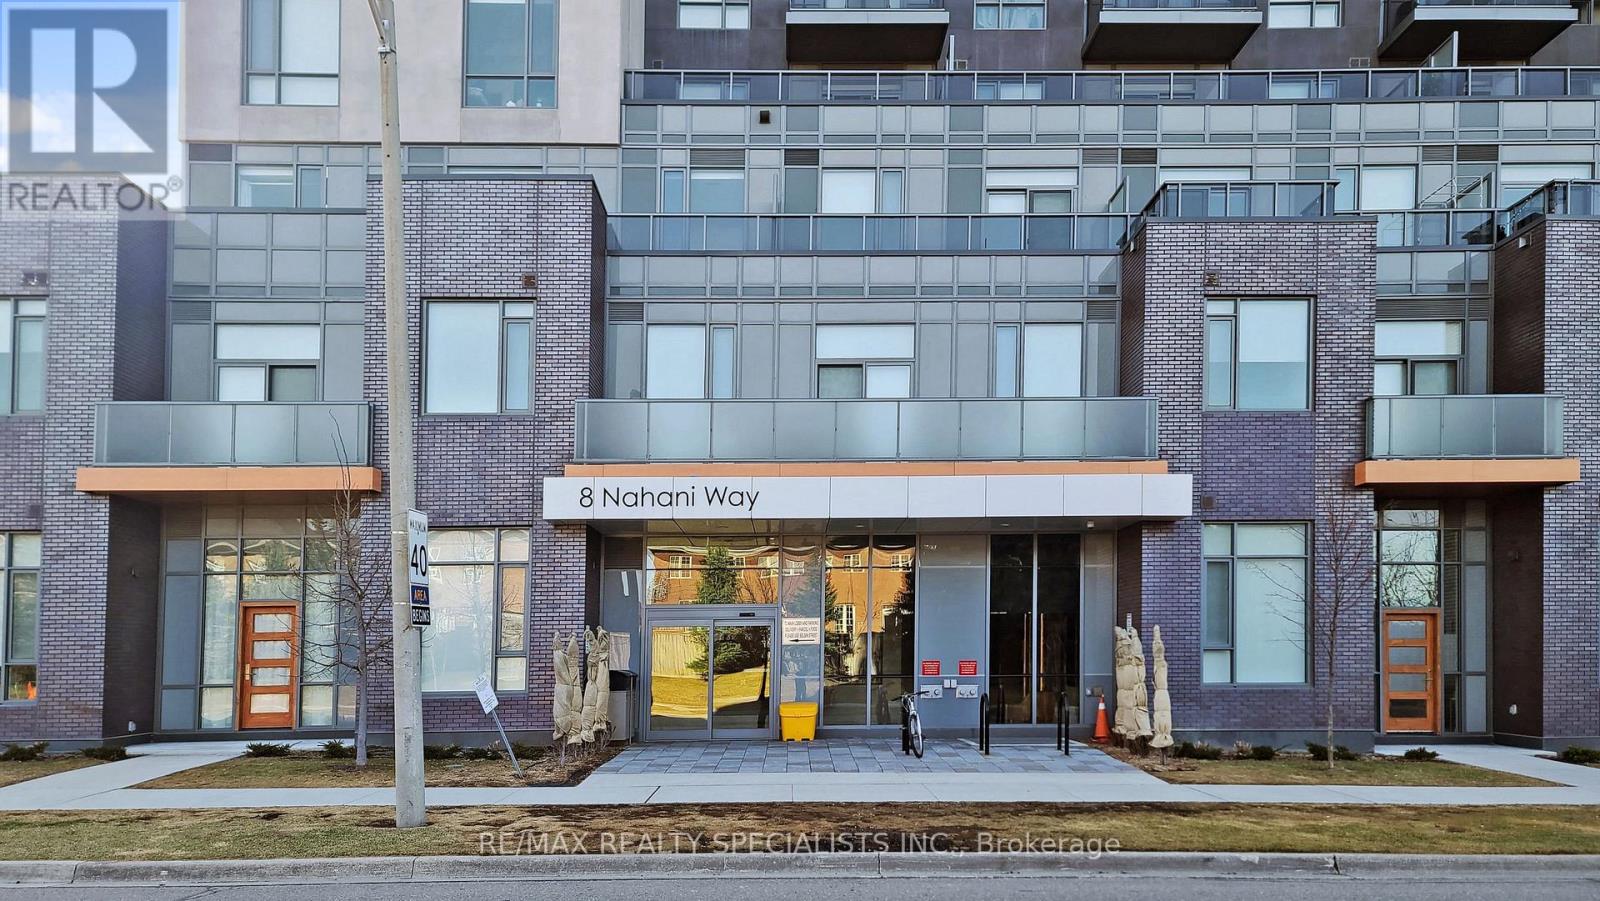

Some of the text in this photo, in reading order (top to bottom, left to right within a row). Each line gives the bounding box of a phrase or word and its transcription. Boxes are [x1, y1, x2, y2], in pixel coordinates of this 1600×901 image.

[579, 486, 760, 511] 8 Nahani Way
[411, 543, 427, 576] 40
[413, 589, 428, 601] AREA
[412, 608, 430, 623] BEGINS
